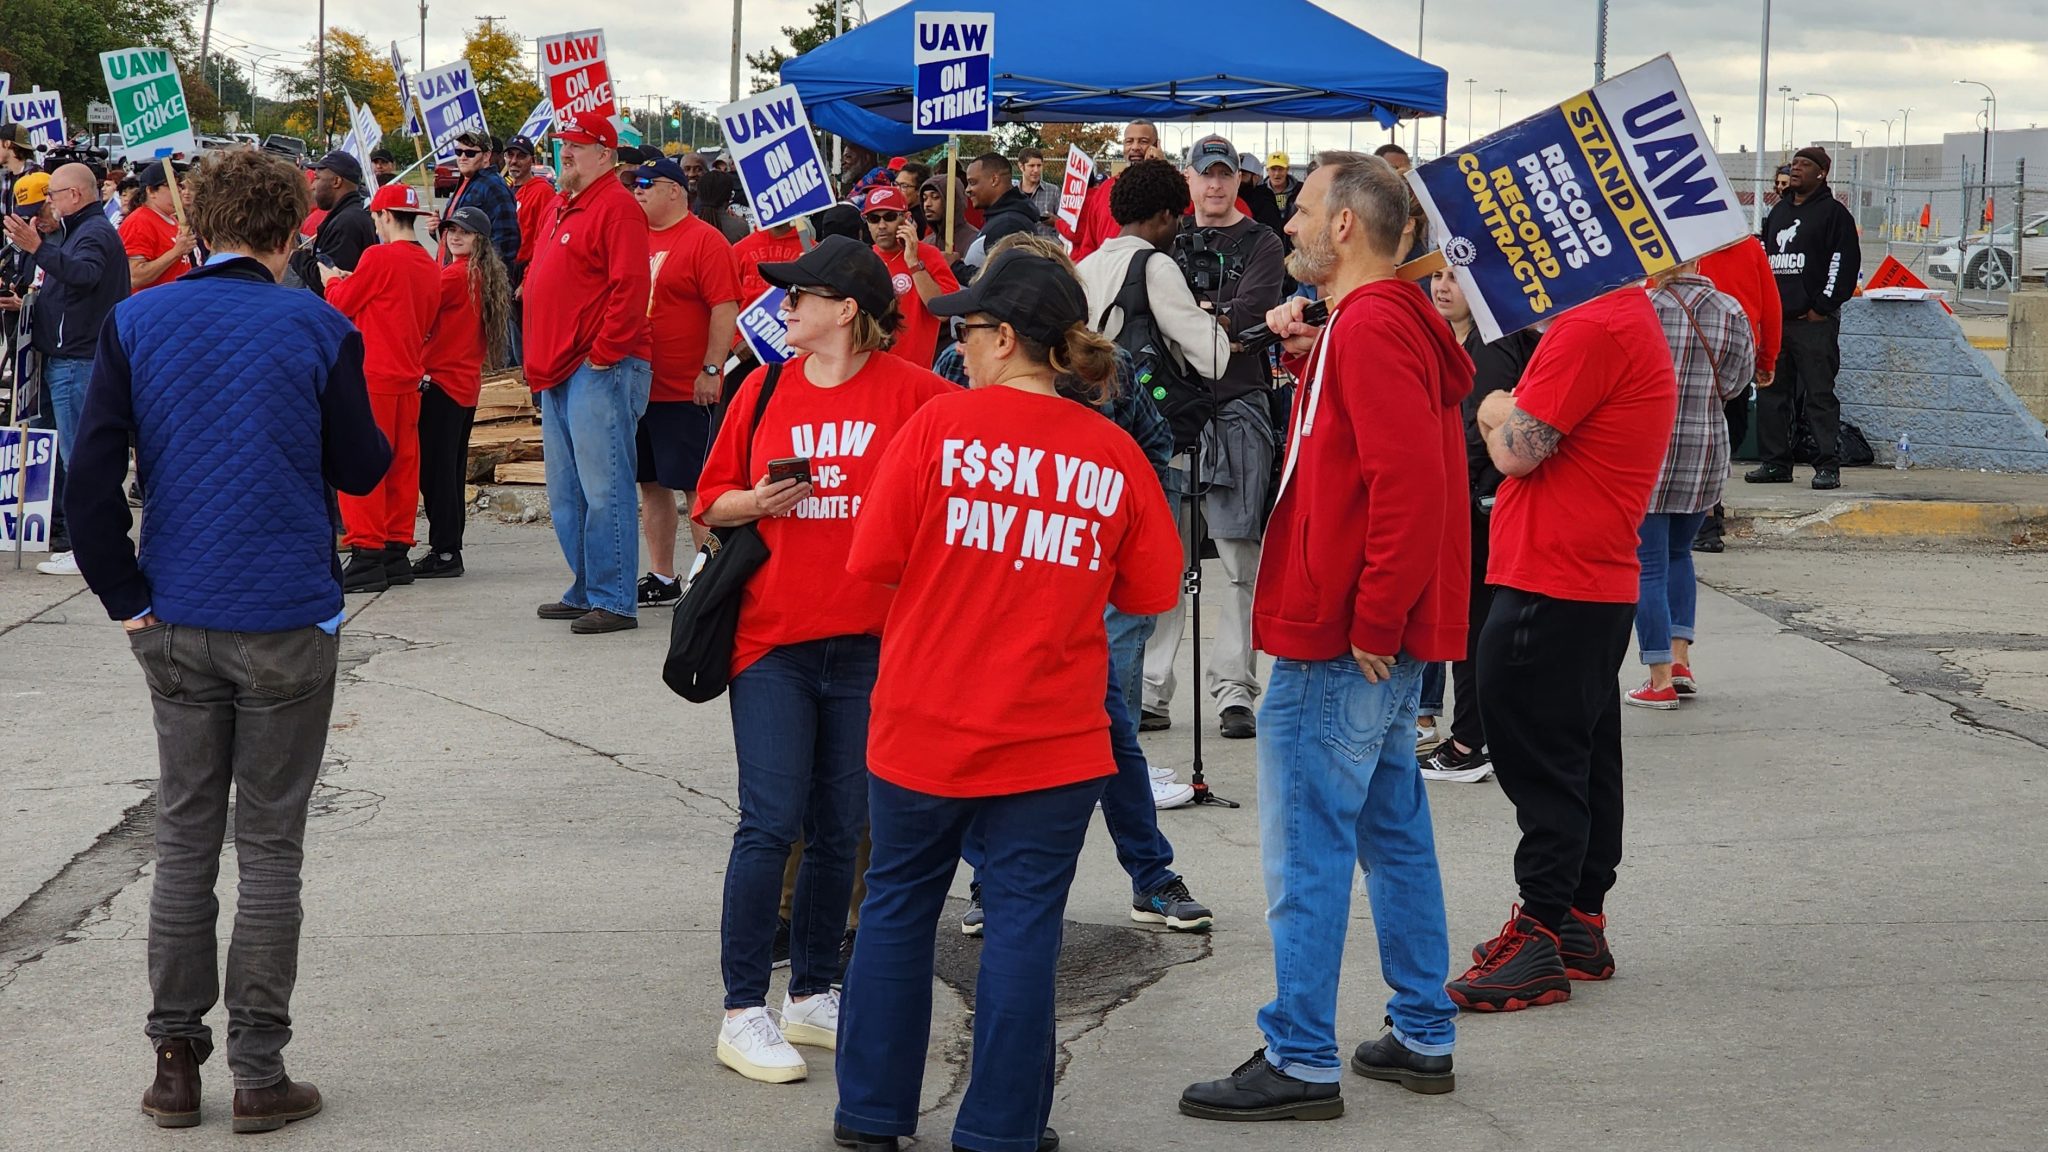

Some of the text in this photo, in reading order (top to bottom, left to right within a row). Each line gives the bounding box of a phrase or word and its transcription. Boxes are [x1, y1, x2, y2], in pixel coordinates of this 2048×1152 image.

[546, 36, 598, 65] UAW
[920, 23, 988, 51] UAW
[108, 51, 167, 80] UAW
[940, 62, 967, 93] ON
[133, 82, 160, 112] ON
[418, 68, 467, 100] UAW
[566, 68, 590, 98] ON
[10, 99, 56, 122] UAW
[123, 94, 184, 146] STRIKE
[442, 99, 463, 126] ON
[725, 96, 796, 144] UAW
[920, 85, 986, 126] STRIKE
[764, 141, 794, 180] ON
[1623, 90, 1729, 220] UAW
[756, 158, 822, 221] STRIKE
[1070, 180, 1083, 194] ON
[1570, 106, 1664, 260] STAND UP
[454, 210, 470, 219] Ford
[1061, 194, 1085, 209] STRIK
[1516, 153, 1590, 270] PROFITS
[1540, 142, 1612, 258] RECORD
[1457, 153, 1553, 314] CONTRACTS
[1489, 166, 1561, 279] RECORD
[749, 245, 798, 262] DETROI
[1878, 263, 1902, 288] AYERS
[20, 304, 33, 336] UA
[791, 420, 876, 458] UAW
[0, 438, 50, 473] STRI
[941, 439, 1125, 518] F$$K YOU
[790, 495, 849, 519] ORATE
[0, 512, 45, 542] UA
[945, 496, 1018, 553] PAY
